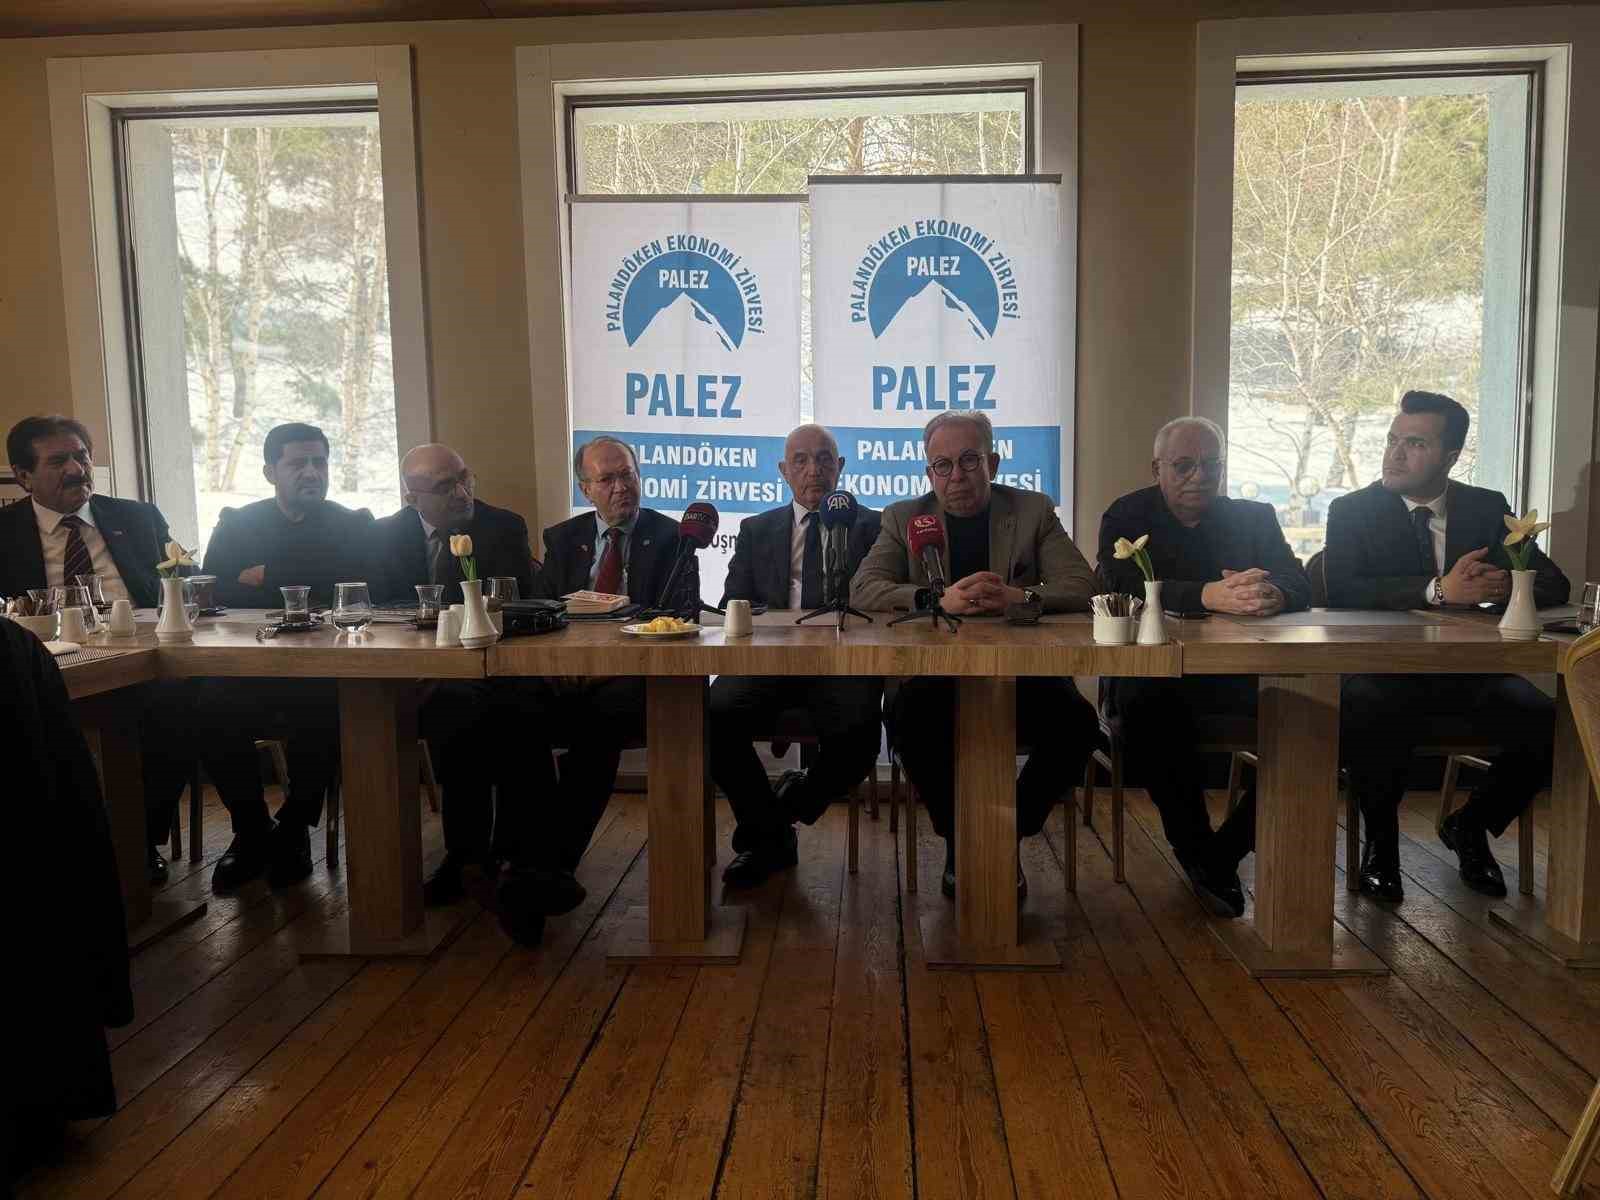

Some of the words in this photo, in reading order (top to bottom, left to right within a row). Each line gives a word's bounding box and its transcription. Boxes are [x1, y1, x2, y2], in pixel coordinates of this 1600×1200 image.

[851, 225, 911, 322] PALANDÖKEN
[915, 219, 995, 255] EKONOMİ
[988, 252, 1021, 319] ZİRVESİ
[907, 255, 960, 276] PALEZ
[606, 239, 662, 332] PALANDÖKEN
[667, 234, 742, 270] EKONOMİ
[735, 268, 765, 334] ZİRVESİ
[659, 269, 709, 289] PALEZ
[626, 373, 742, 418] PALEZ
[873, 365, 997, 410] PALEZ
[630, 442, 757, 467] LANDÖKEN
[696, 475, 783, 502] ZİRVESİ
[836, 474, 934, 496] KONOM
[828, 495, 849, 511] AA
